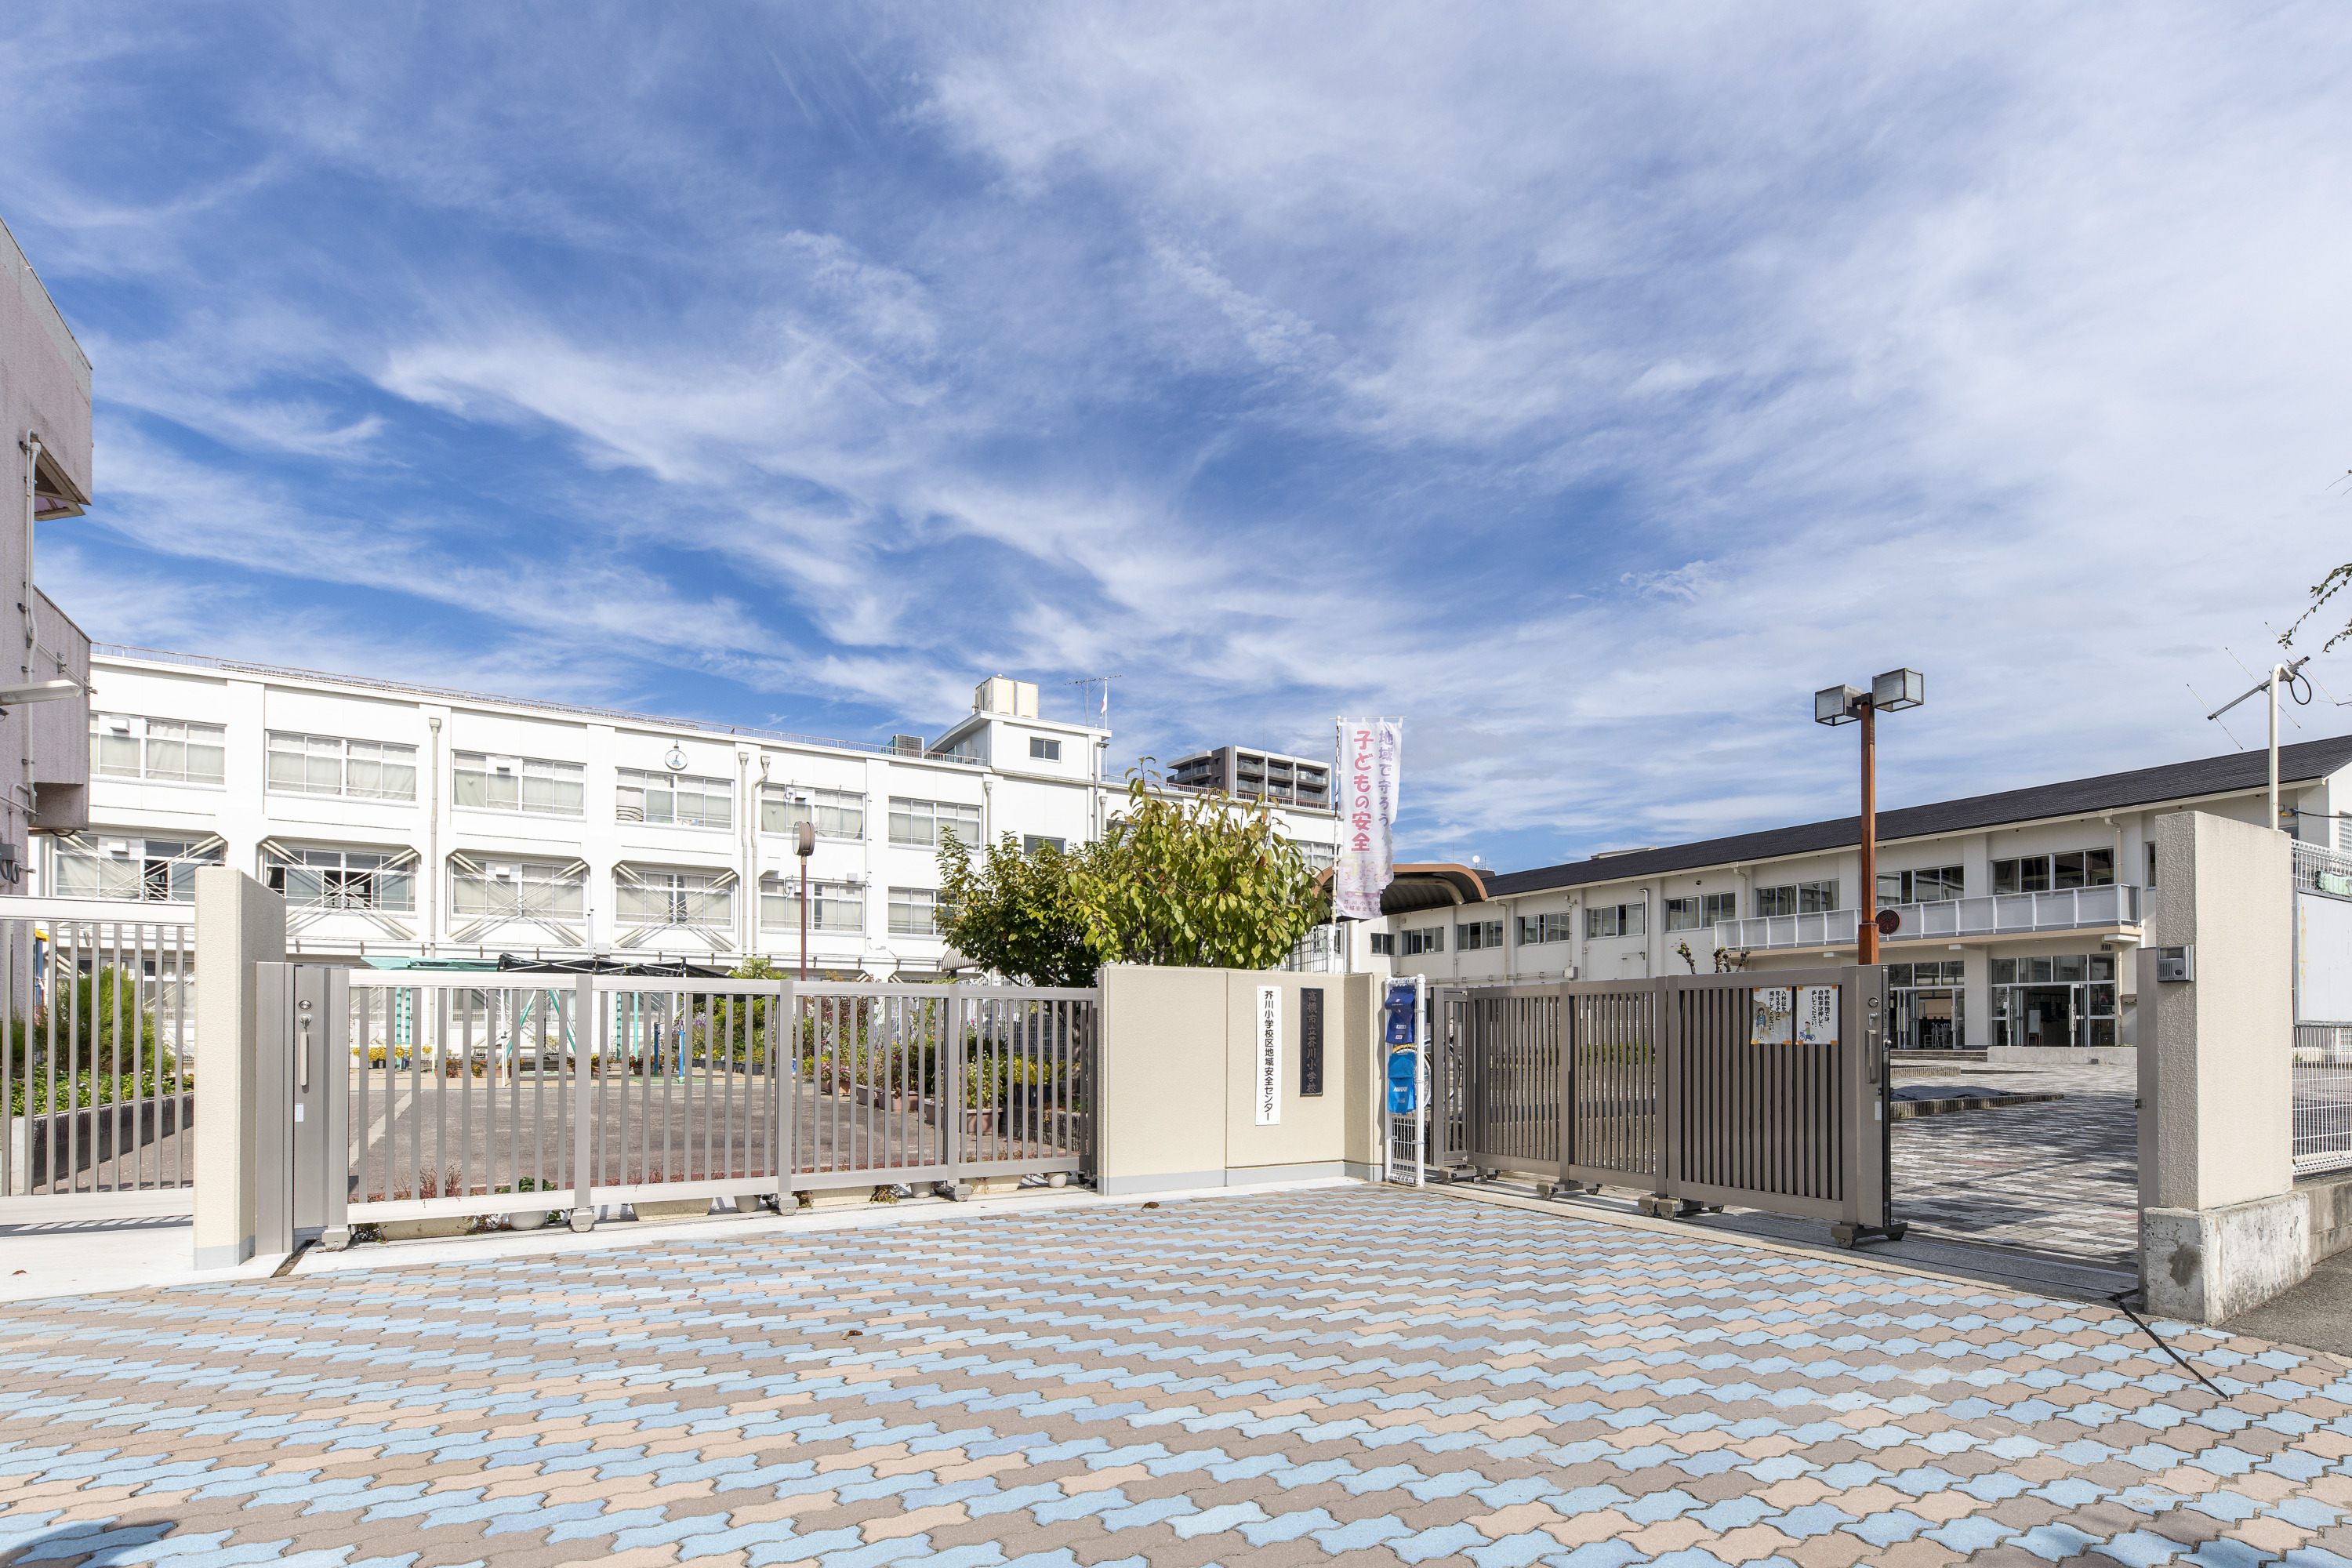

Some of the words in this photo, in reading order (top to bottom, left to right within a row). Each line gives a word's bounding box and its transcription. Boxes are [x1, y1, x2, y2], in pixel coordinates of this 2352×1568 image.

[1351, 731, 1374, 851] 子どもの安全
[1378, 730, 1393, 827] 地域で守ろう
[1264, 990, 1274, 1121] 芥川小学校区地域安全センター
[1306, 990, 1318, 1094] 高槻市立芥川小学校
